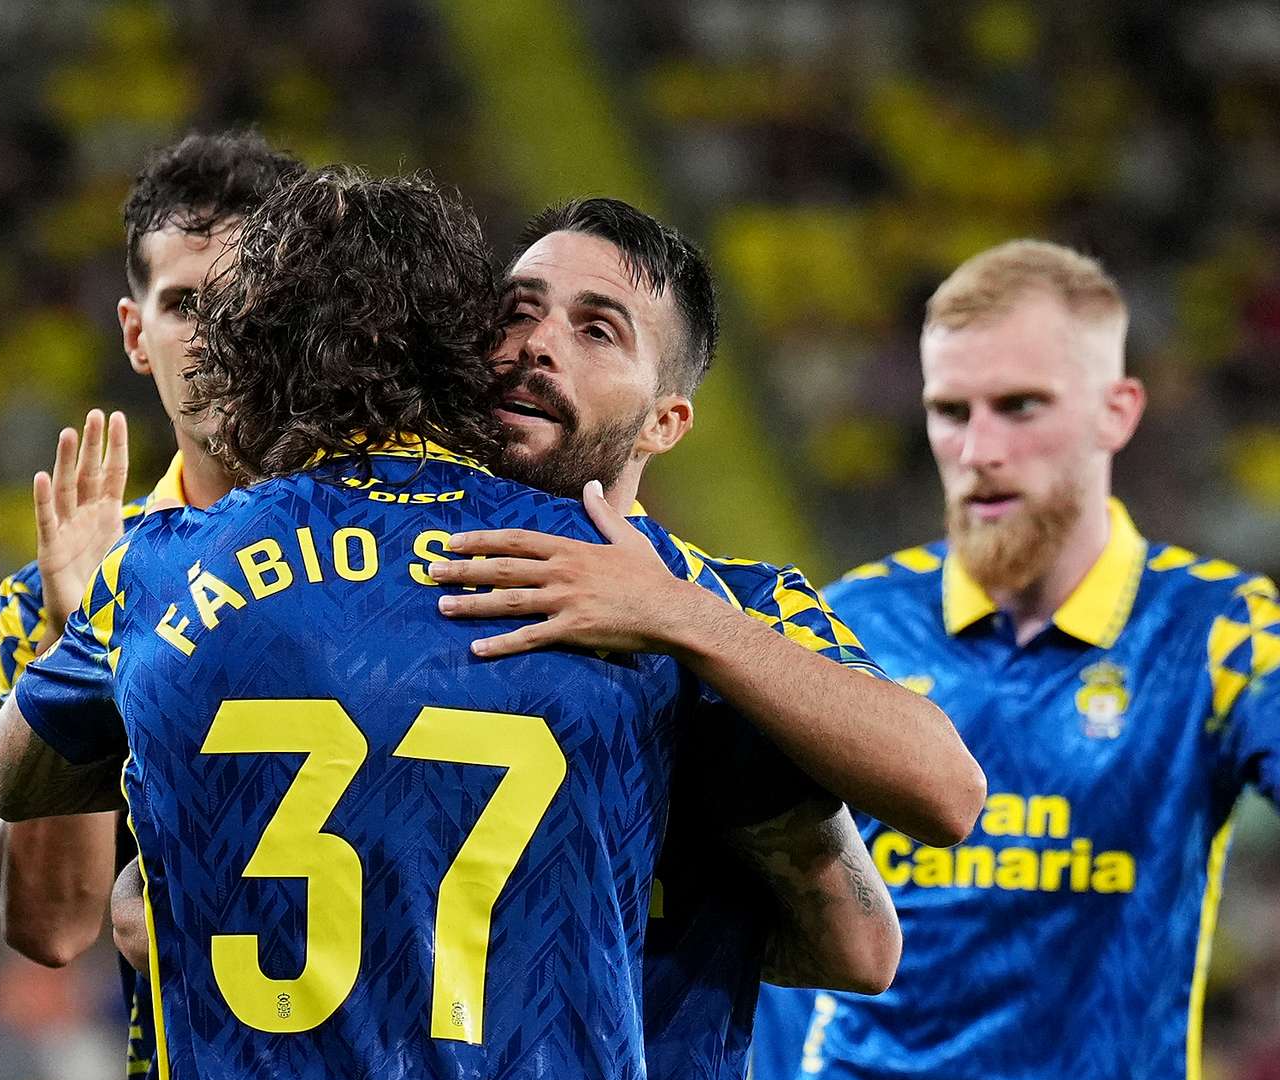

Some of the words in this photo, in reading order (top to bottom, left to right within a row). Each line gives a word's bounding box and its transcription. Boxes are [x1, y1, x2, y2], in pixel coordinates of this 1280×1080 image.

[154, 526, 380, 657] FÁBIO
[872, 830, 1136, 894] Canaria
[982, 793, 1071, 839] an
[199, 698, 568, 1045] 37
